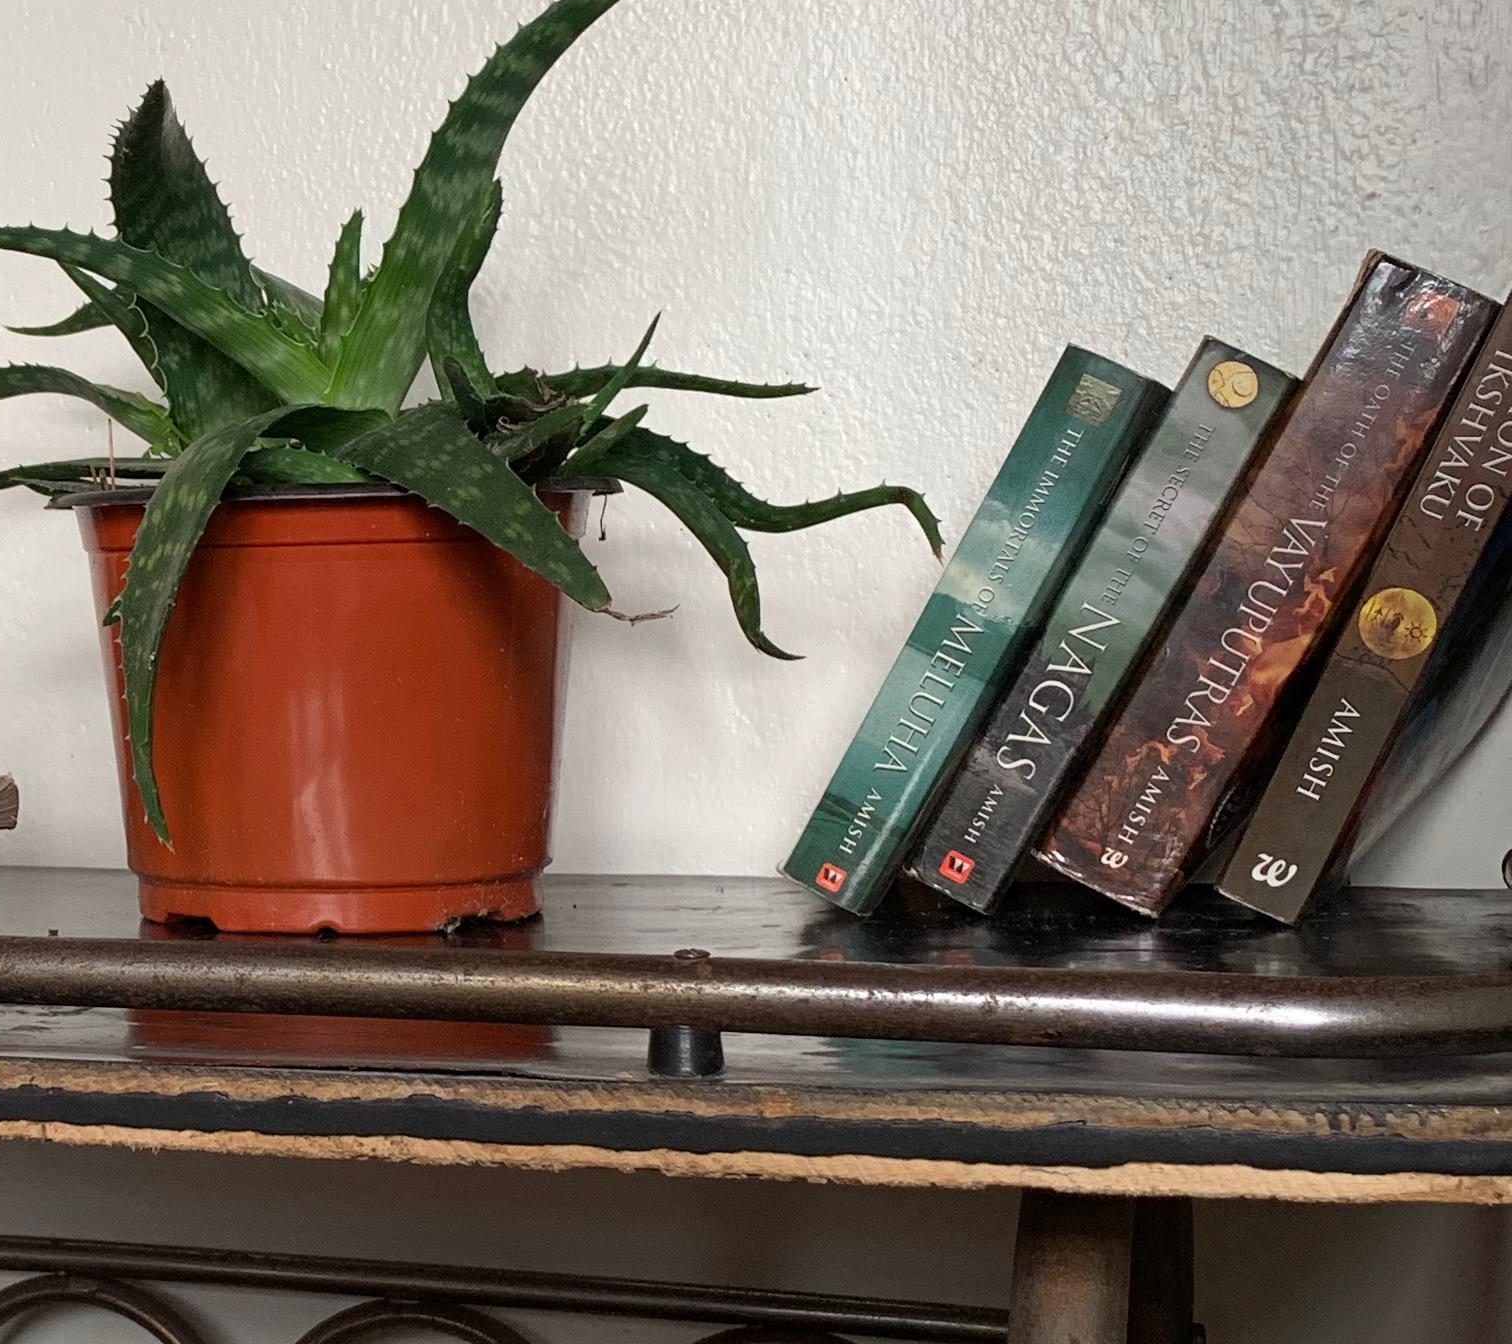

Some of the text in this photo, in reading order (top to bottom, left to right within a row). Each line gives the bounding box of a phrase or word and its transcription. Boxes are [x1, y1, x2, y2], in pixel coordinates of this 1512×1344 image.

[1335, 443, 1357, 471] OF
[1351, 384, 1390, 439] OATH
[1419, 350, 1512, 521] IKSHVAKU
[972, 428, 1084, 617] THE IMMORTALS OF
[1101, 423, 1216, 607] THE SECRET OF THE
[1308, 474, 1342, 512] THE
[1455, 483, 1495, 532] OF
[1166, 516, 1329, 754] VAYUPUTRAS
[874, 613, 985, 774] MELUHA
[996, 600, 1122, 783] NAGAS
[1296, 697, 1361, 801] AMISH
[838, 788, 883, 855] AMISH
[962, 784, 1004, 845] AMISH
[1117, 765, 1170, 844] AMISH
